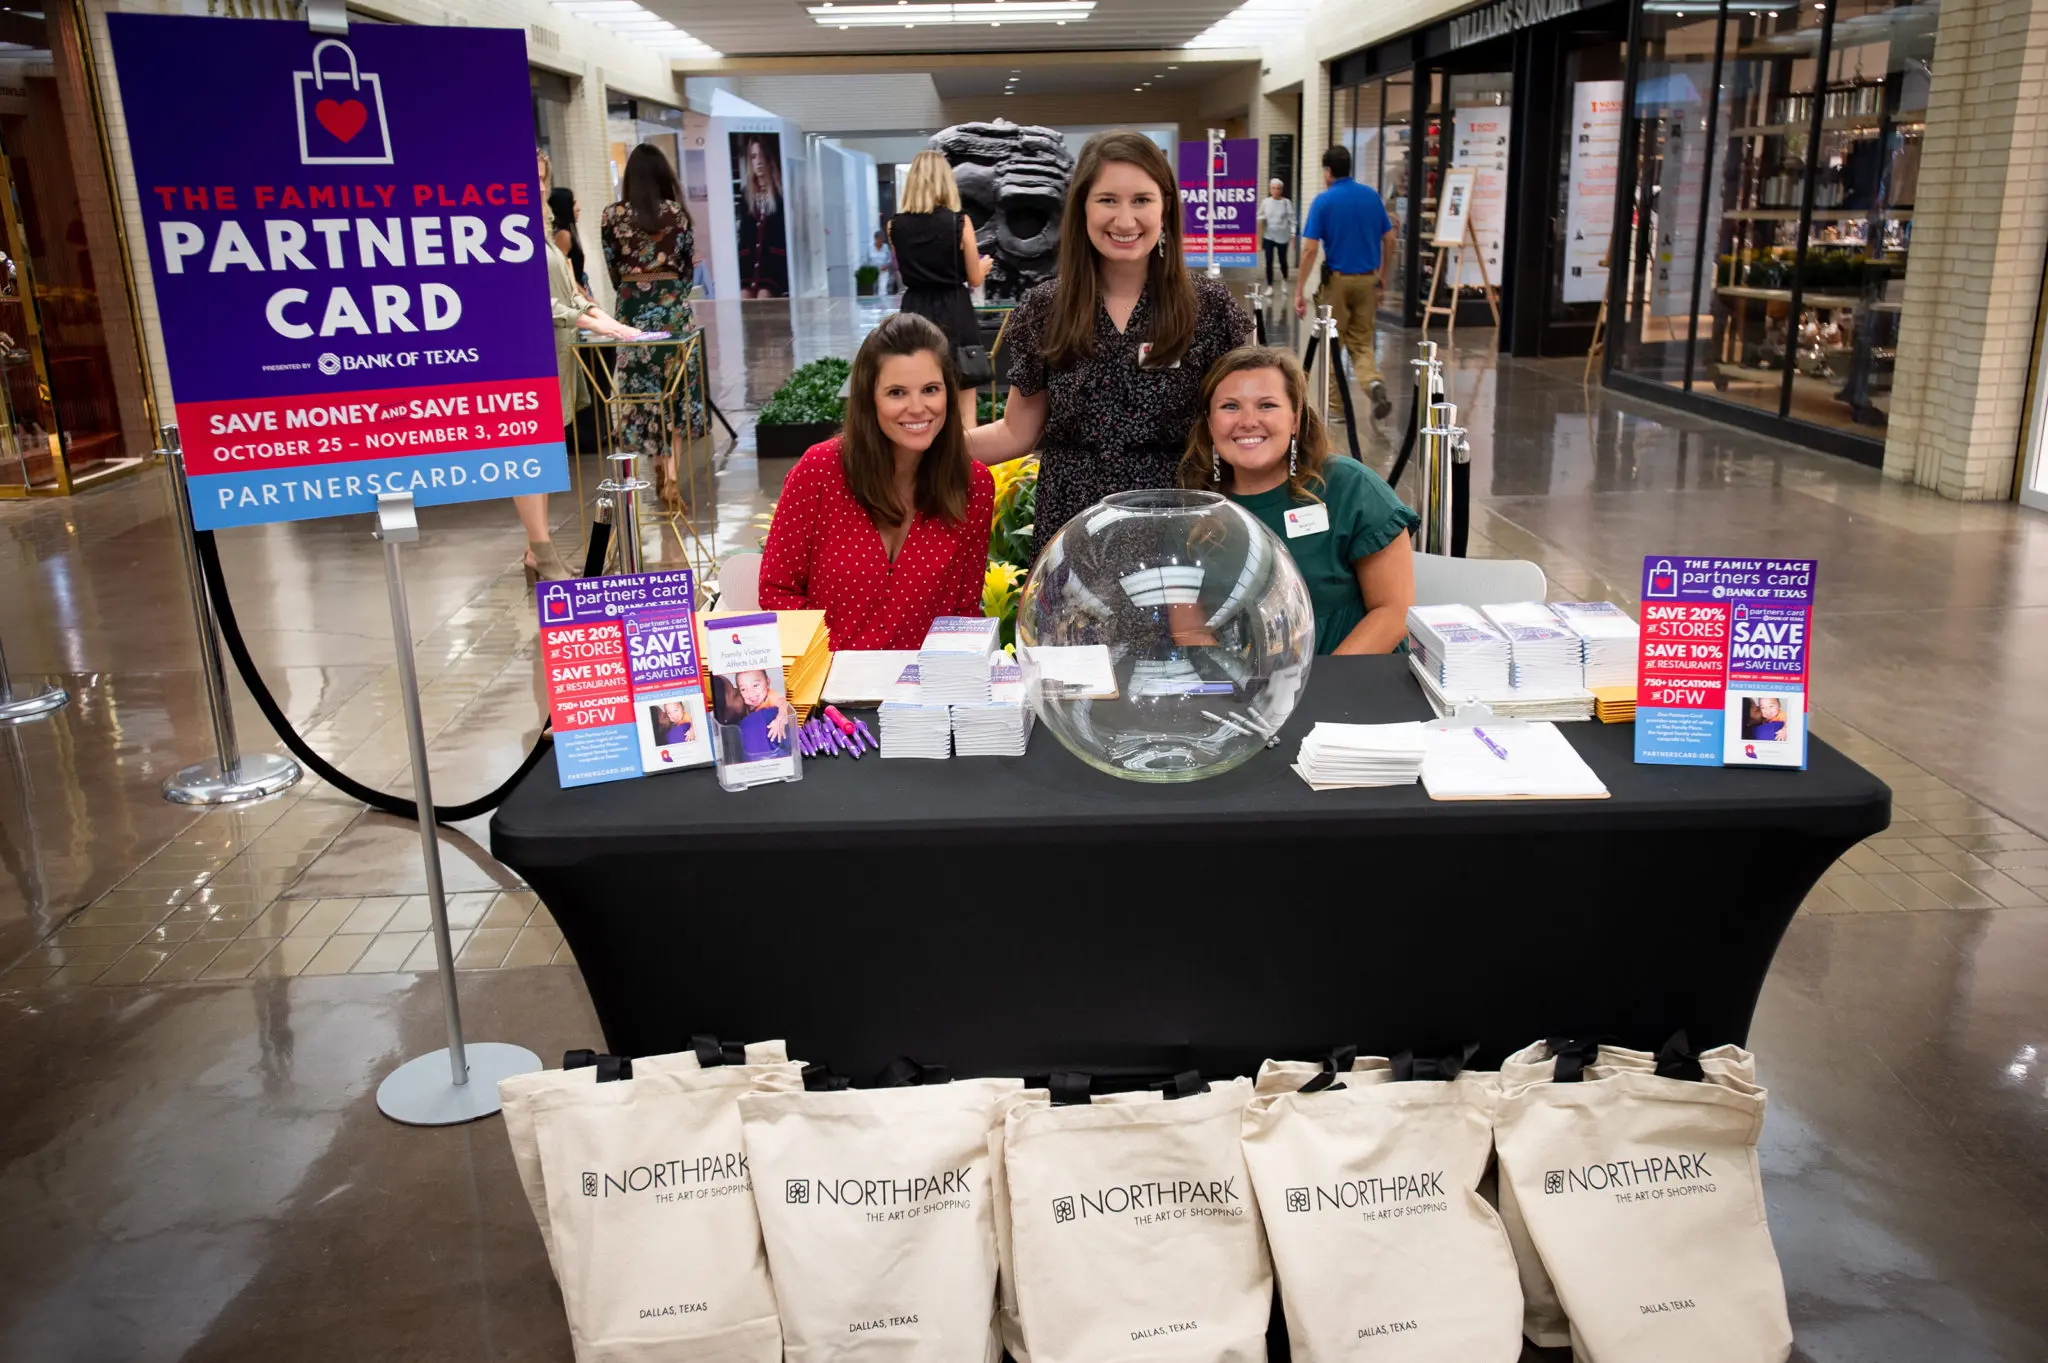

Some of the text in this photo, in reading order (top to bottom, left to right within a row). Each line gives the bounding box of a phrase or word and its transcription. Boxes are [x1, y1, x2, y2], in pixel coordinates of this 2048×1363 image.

[154, 183, 529, 211] THE FAMILY PLACE
[1180, 188, 1255, 203] PARNERS
[159, 214, 534, 274] PARTNERS
[265, 282, 462, 339] CARD
[262, 348, 480, 372] PRESENTED BY BANK OF TEXAS
[209, 391, 539, 436] SAVE MONEY AND SAVE LIVES
[213, 439, 310, 462] OCTOBER
[318, 437, 342, 453] 25
[366, 426, 468, 449] NOVEMBER
[475, 424, 491, 441] 3,
[497, 420, 538, 437] 2019
[217, 458, 542, 509] PARTNERSCARD.ORG
[1684, 560, 1810, 571] THE FAMILY PLACE
[575, 573, 687, 591] THE FAMILY PLACE
[1682, 570, 1809, 586] partners card
[575, 582, 689, 608] partners card
[1726, 588, 1807, 598] BANK OF TEXAS
[671, 616, 688, 625] card
[1646, 607, 1725, 621] SAVE 20%
[548, 625, 622, 645] SAVE 20%
[1659, 622, 1724, 637] STORES
[1733, 621, 1803, 644] SAVE
[562, 639, 623, 660] STORES
[629, 630, 691, 656] SAVE
[1645, 644, 1723, 659] SAVE 10%
[1732, 643, 1801, 660] MONEY
[632, 651, 691, 672] MONEY
[721, 648, 770, 659] Family Violence
[726, 656, 768, 668] Affects Us All
[552, 662, 626, 682] SAVE 10%
[645, 670, 670, 681] SAVE
[671, 666, 695, 678] LIVES
[1657, 660, 1723, 670] RESTAURANTS
[1745, 660, 1771, 670] SAVE
[1773, 662, 1801, 671] LIVES
[566, 677, 627, 692] RESTAURANTS
[1644, 679, 1721, 688] 750+ LOCATIONS
[556, 695, 629, 711] 750+ LOCATIONS
[1663, 689, 1705, 704] DFW
[577, 707, 616, 725] DFW
[605, 1152, 750, 1197] NORTHPARK
[1568, 1152, 1712, 1193] NORTHPARK
[656, 1193, 674, 1203] THE
[677, 1190, 697, 1200] ART
[697, 1189, 708, 1198] OF
[818, 1167, 971, 1206] NORTHPARK
[1316, 1171, 1445, 1211] NORTHPARK
[1615, 1183, 1717, 1204] THE ART OF SHOPPING
[1080, 1175, 1239, 1218] NORTHPARK
[866, 1199, 971, 1222] THE ART OF SHOPPING
[1134, 1207, 1243, 1226] THE ART OF SHOPPING
[1362, 1202, 1448, 1222] THE ART OF SHOPPING
[639, 1301, 708, 1319] DALLAS, TEXAS
[1640, 1299, 1696, 1314] DALLAS, TEXAS
[849, 1314, 919, 1332] DALLAS, TEXAS
[1130, 1320, 1198, 1341] DALLAS, TEXAS
[1358, 1319, 1418, 1339] DALLAS, TEXAS
